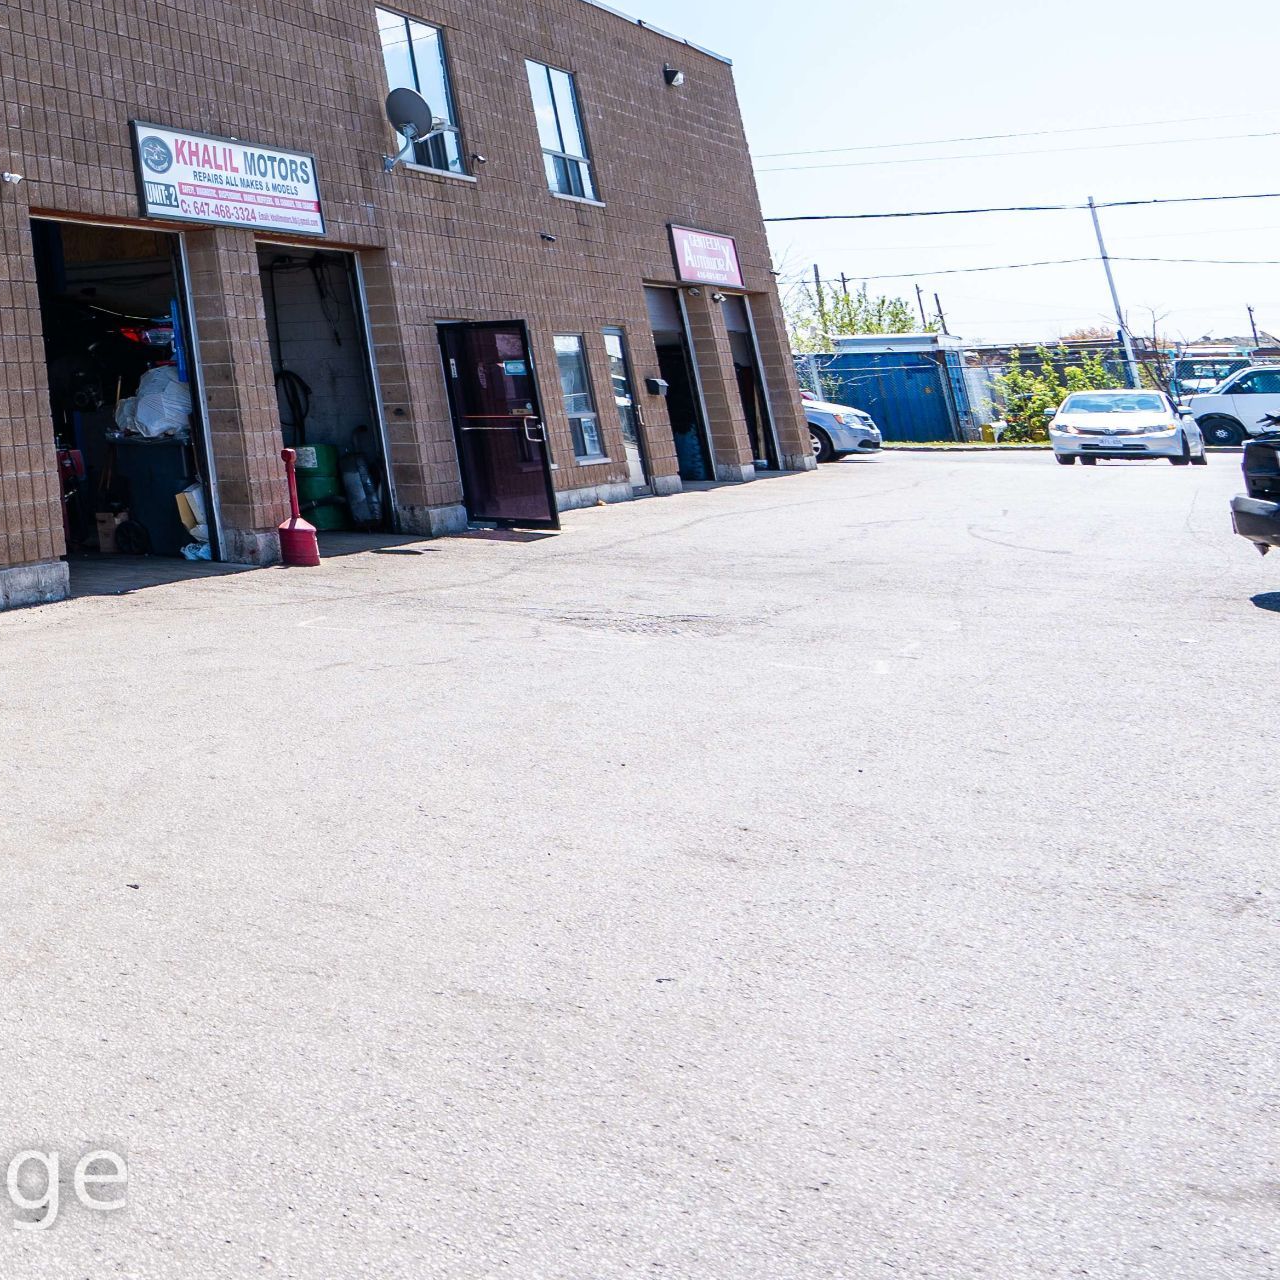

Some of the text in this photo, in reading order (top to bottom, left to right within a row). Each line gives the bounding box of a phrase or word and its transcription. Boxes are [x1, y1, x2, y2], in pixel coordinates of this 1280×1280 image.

[174, 138, 239, 174] KHALIL
[243, 151, 310, 185] MOTORS
[145, 182, 178, 206] UNIT: 2
[193, 170, 299, 196] REPAIRS ALL MAKES & MODELS
[181, 199, 192, 215] C:
[193, 200, 257, 222] 647-468-3324
